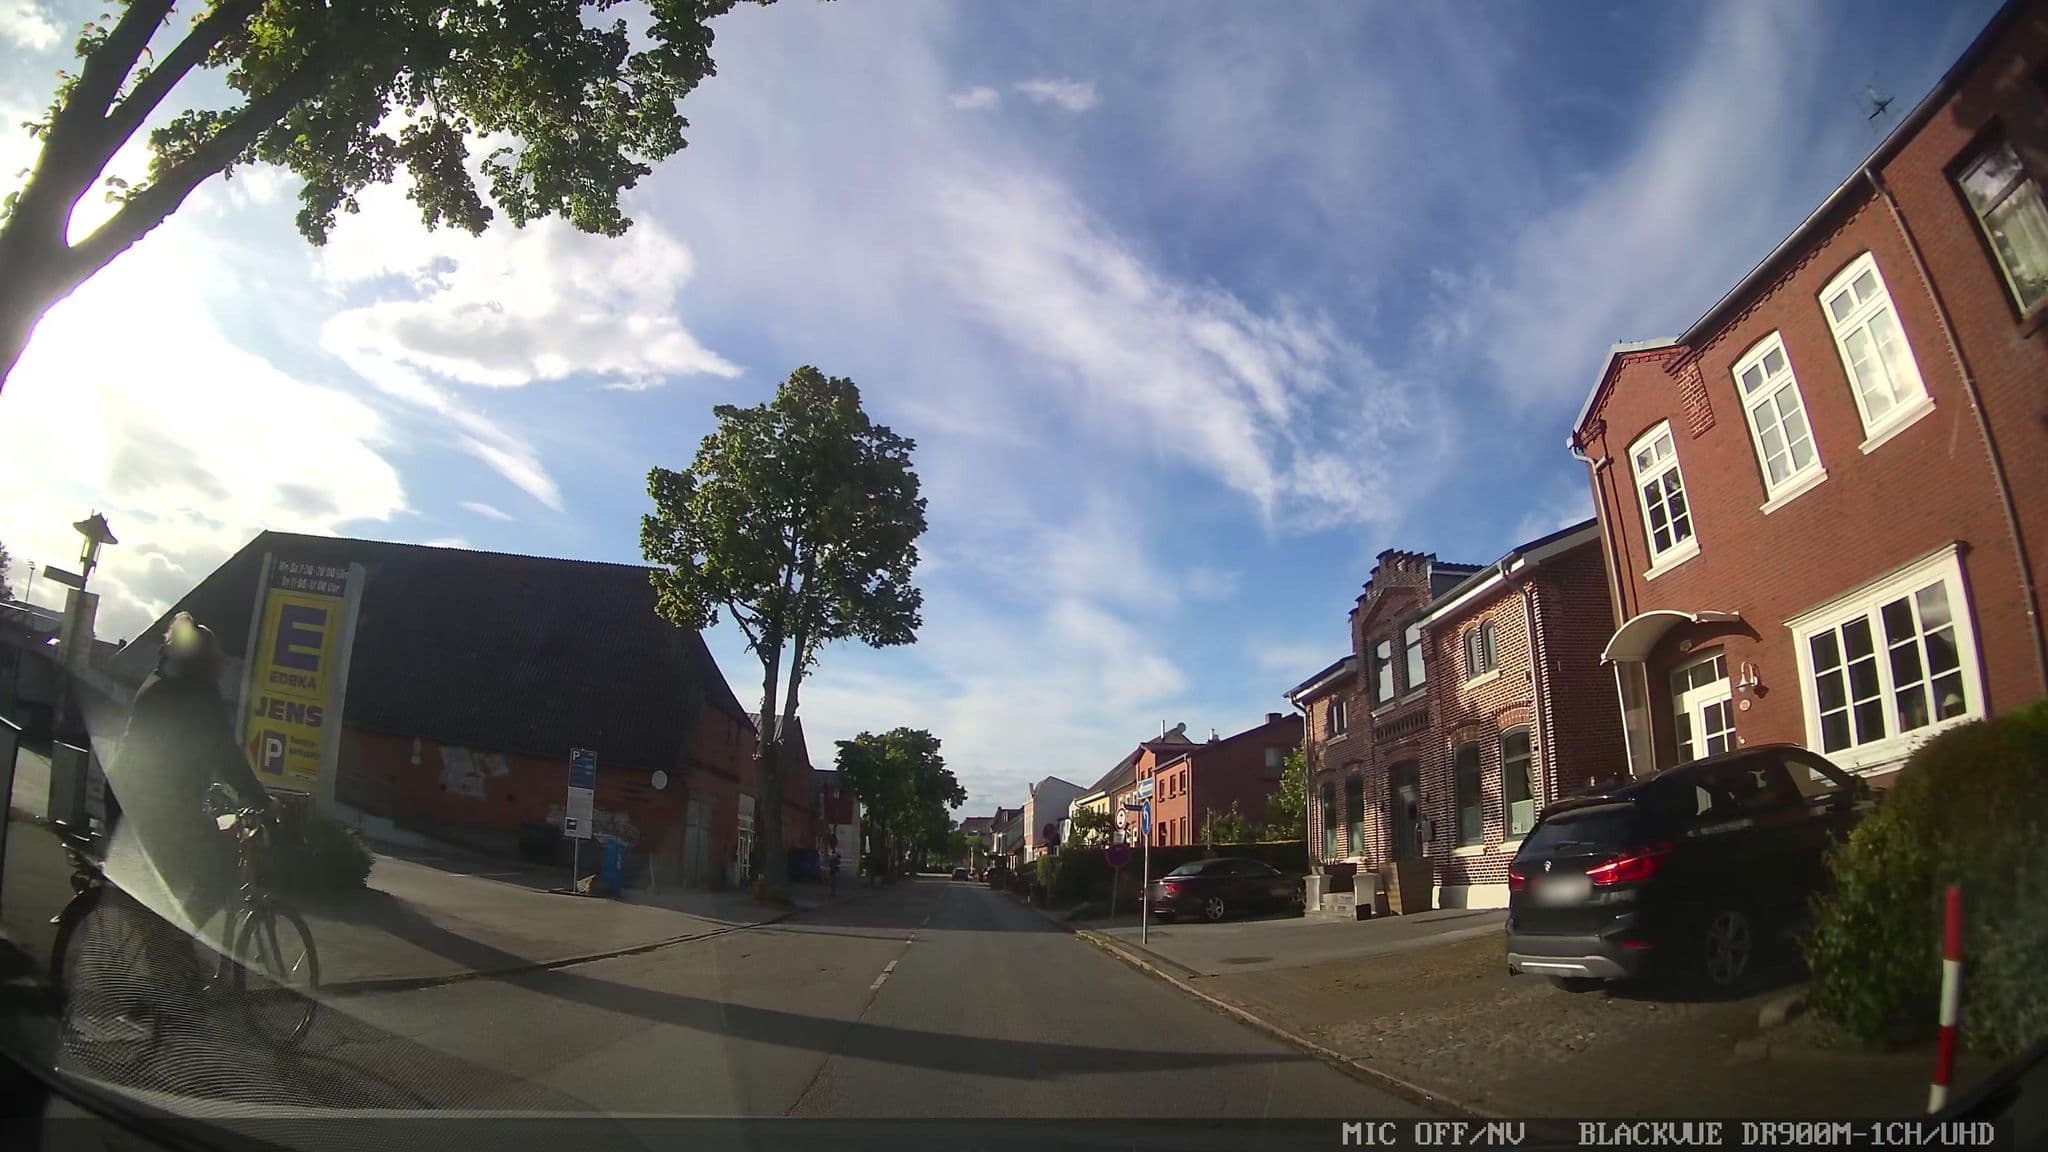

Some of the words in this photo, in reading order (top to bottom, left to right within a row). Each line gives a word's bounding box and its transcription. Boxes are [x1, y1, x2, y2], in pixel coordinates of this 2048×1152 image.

[273, 604, 327, 672] E
[270, 671, 316, 690] EDEKA
[256, 696, 323, 728] JENS
[264, 738, 283, 767] P
